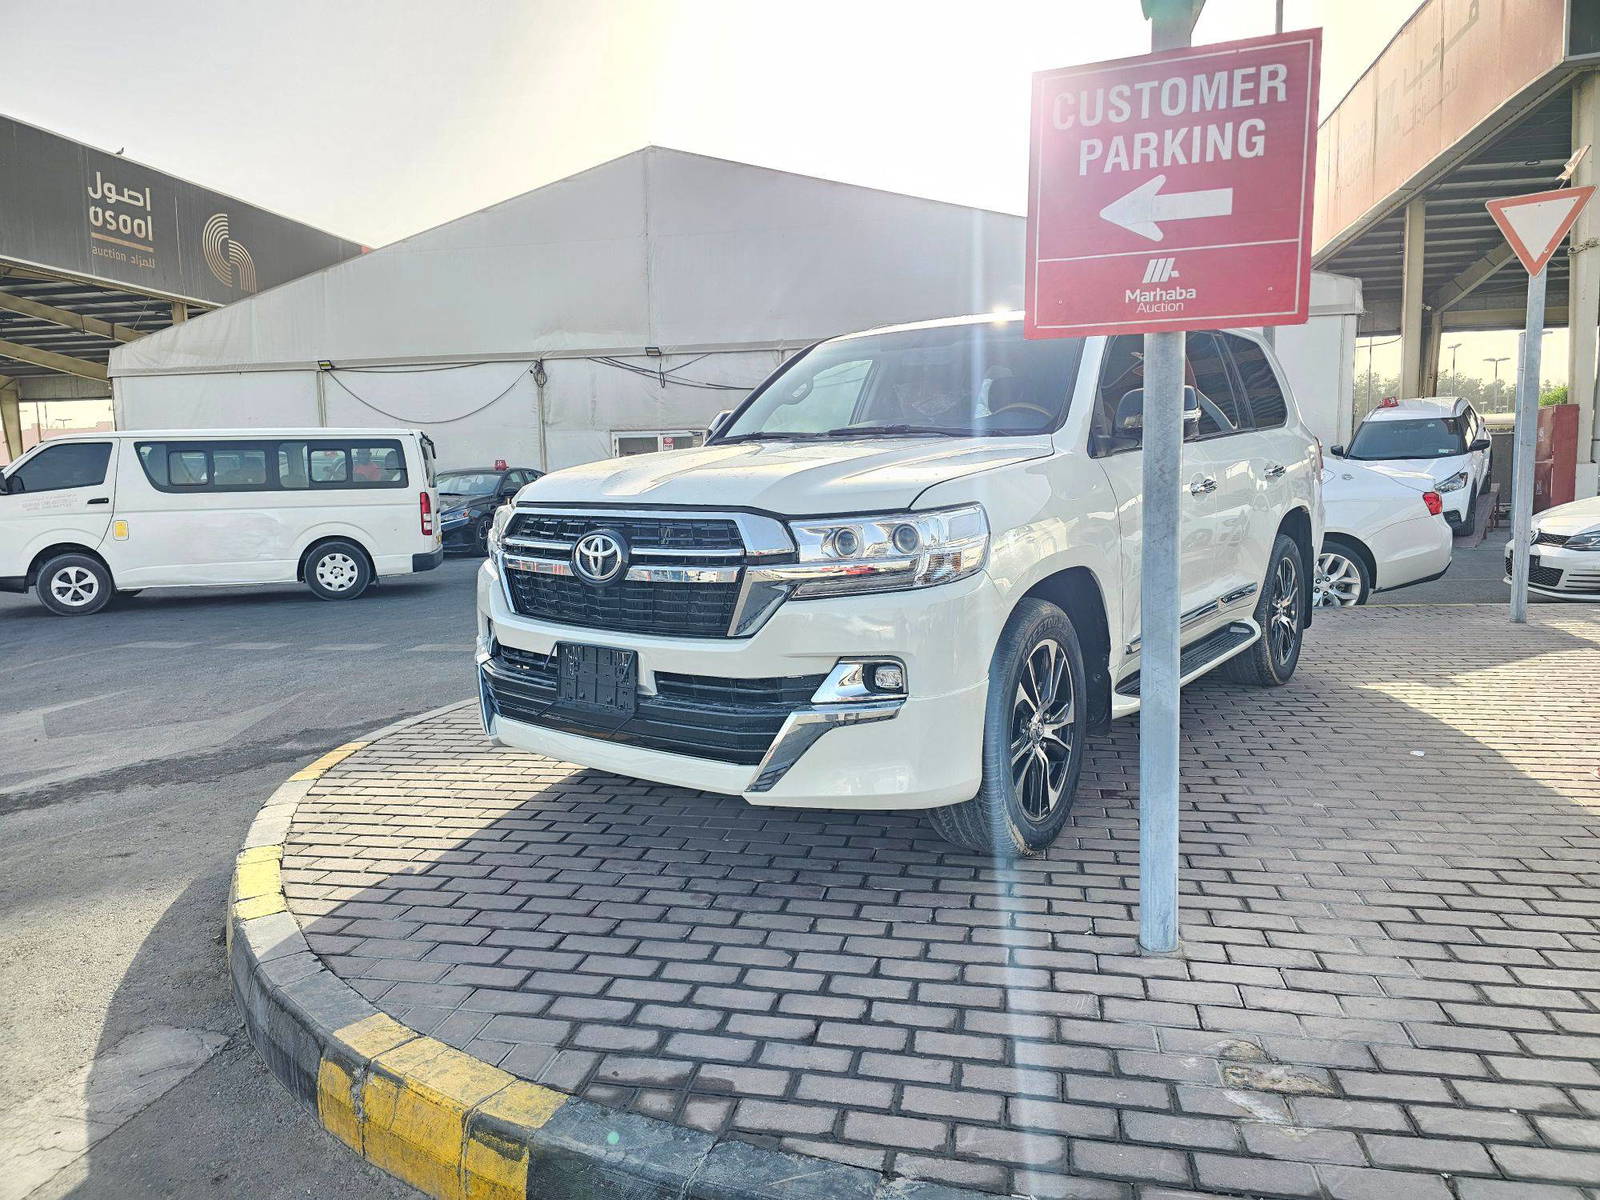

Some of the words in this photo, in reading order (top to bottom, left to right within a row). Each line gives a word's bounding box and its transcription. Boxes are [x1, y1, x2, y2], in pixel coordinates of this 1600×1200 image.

[1052, 63, 1288, 130] CUSTOMER
[1079, 118, 1266, 176] PARKING
[88, 171, 151, 211] اصول
[91, 246, 127, 262] auction
[1125, 286, 1197, 303] Marhaba
[1136, 300, 1184, 313] Auction
